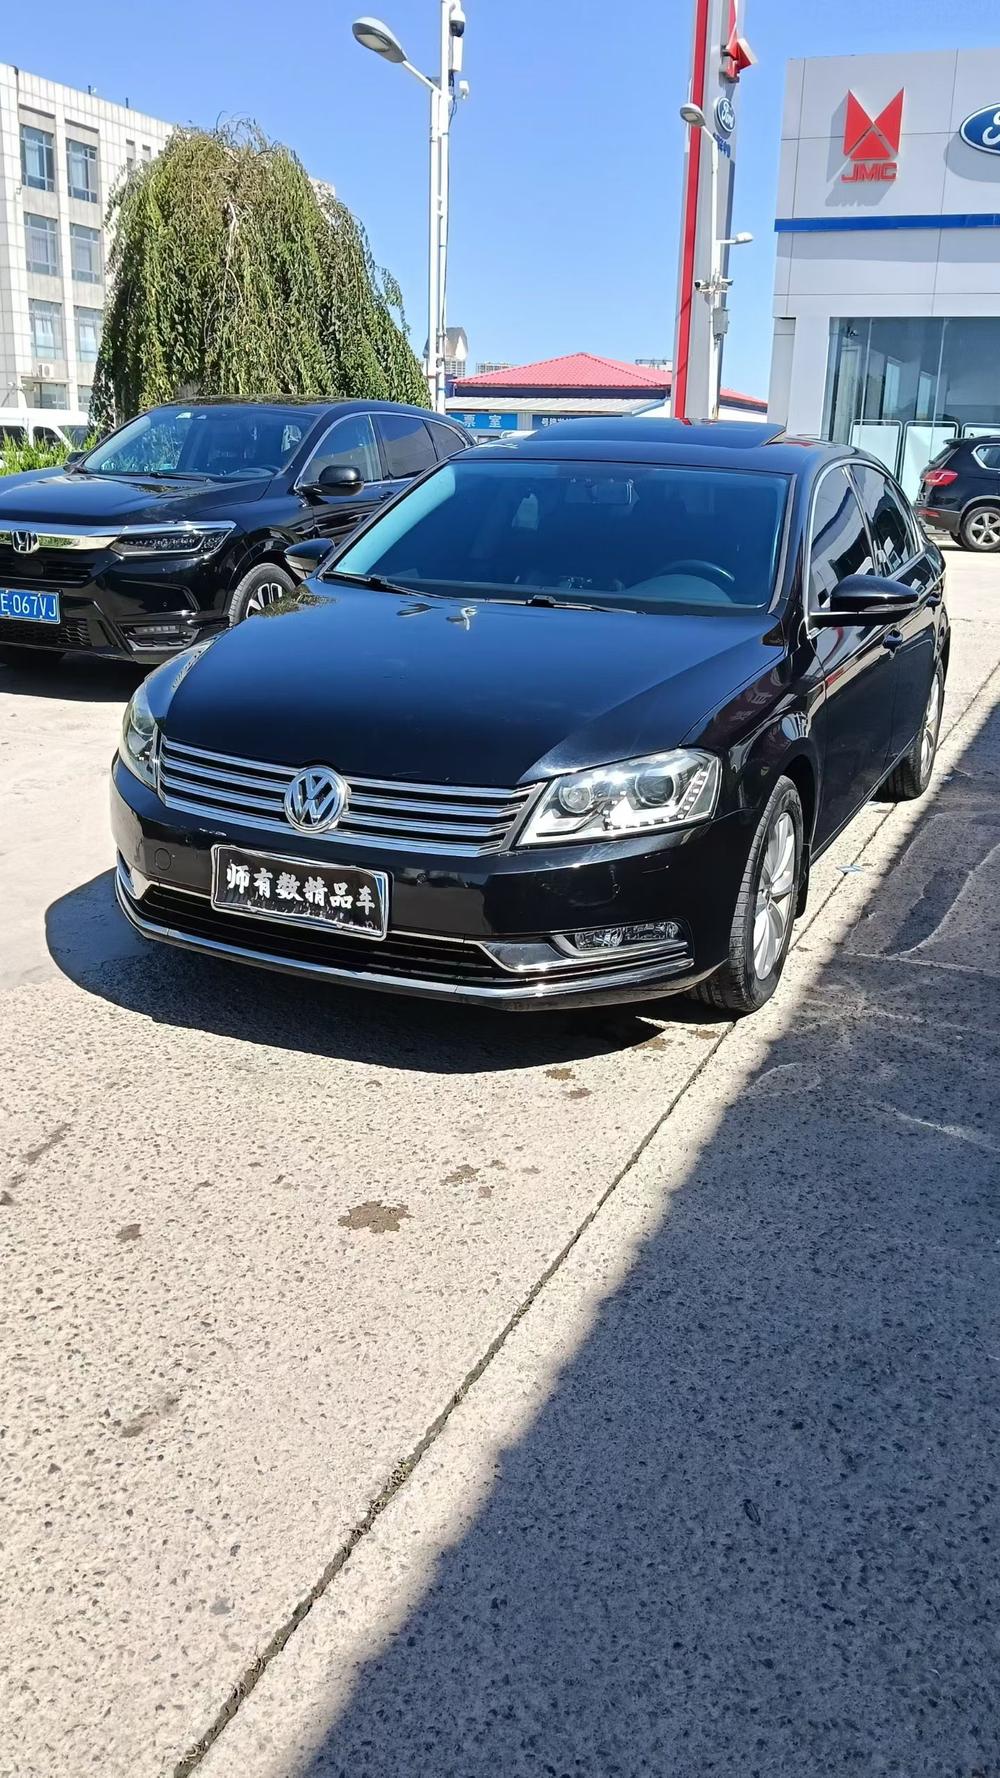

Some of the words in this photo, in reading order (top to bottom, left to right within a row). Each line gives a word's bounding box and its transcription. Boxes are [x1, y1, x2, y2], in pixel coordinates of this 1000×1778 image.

[841, 162, 897, 183] JMC
[226, 862, 375, 915] 师有数精品车
